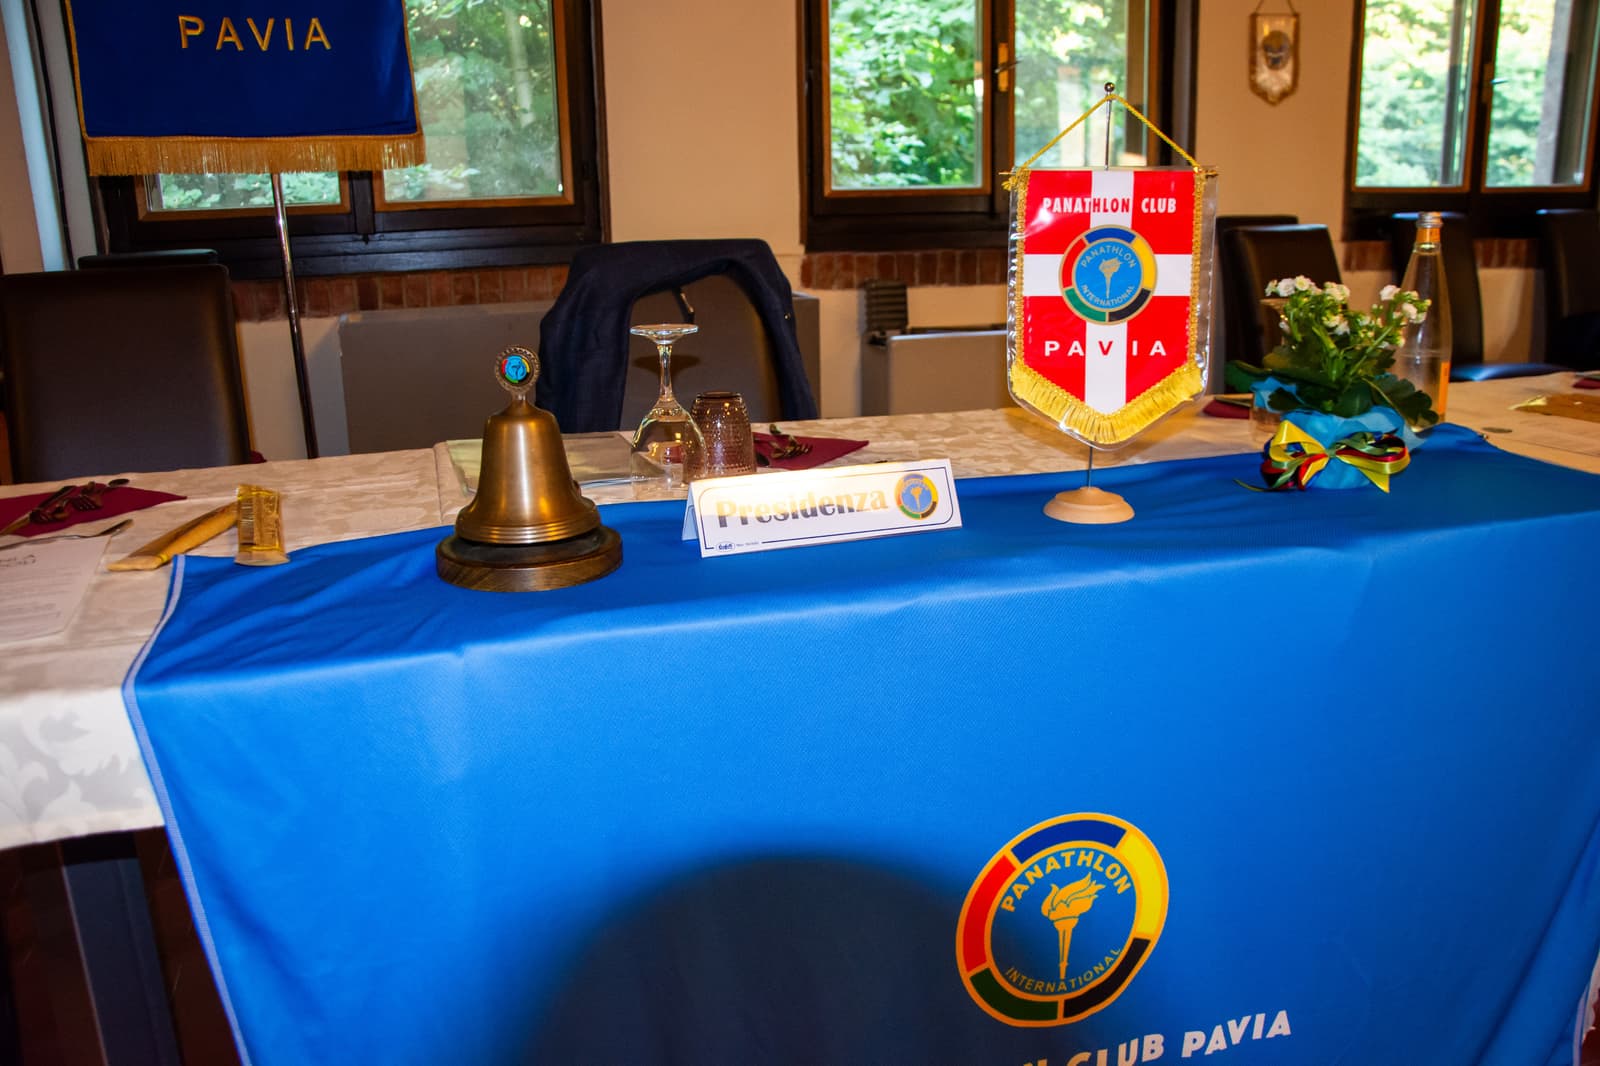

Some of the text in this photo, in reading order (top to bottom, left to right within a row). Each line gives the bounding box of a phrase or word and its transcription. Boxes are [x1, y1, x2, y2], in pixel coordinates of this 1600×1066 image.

[178, 15, 332, 51] PAVIA
[1042, 197, 1177, 214] PANATHLON CLUB
[1081, 245, 1137, 268] PANATHLON
[1081, 284, 1136, 307] INTERNATIONAL
[1044, 340, 1167, 357] PAVIA
[715, 488, 888, 528] Presidenza
[1001, 850, 1131, 912] PANATHLON
[1006, 947, 1121, 993] INTERNATIONAL
[1181, 1010, 1292, 1058] PAVIA
